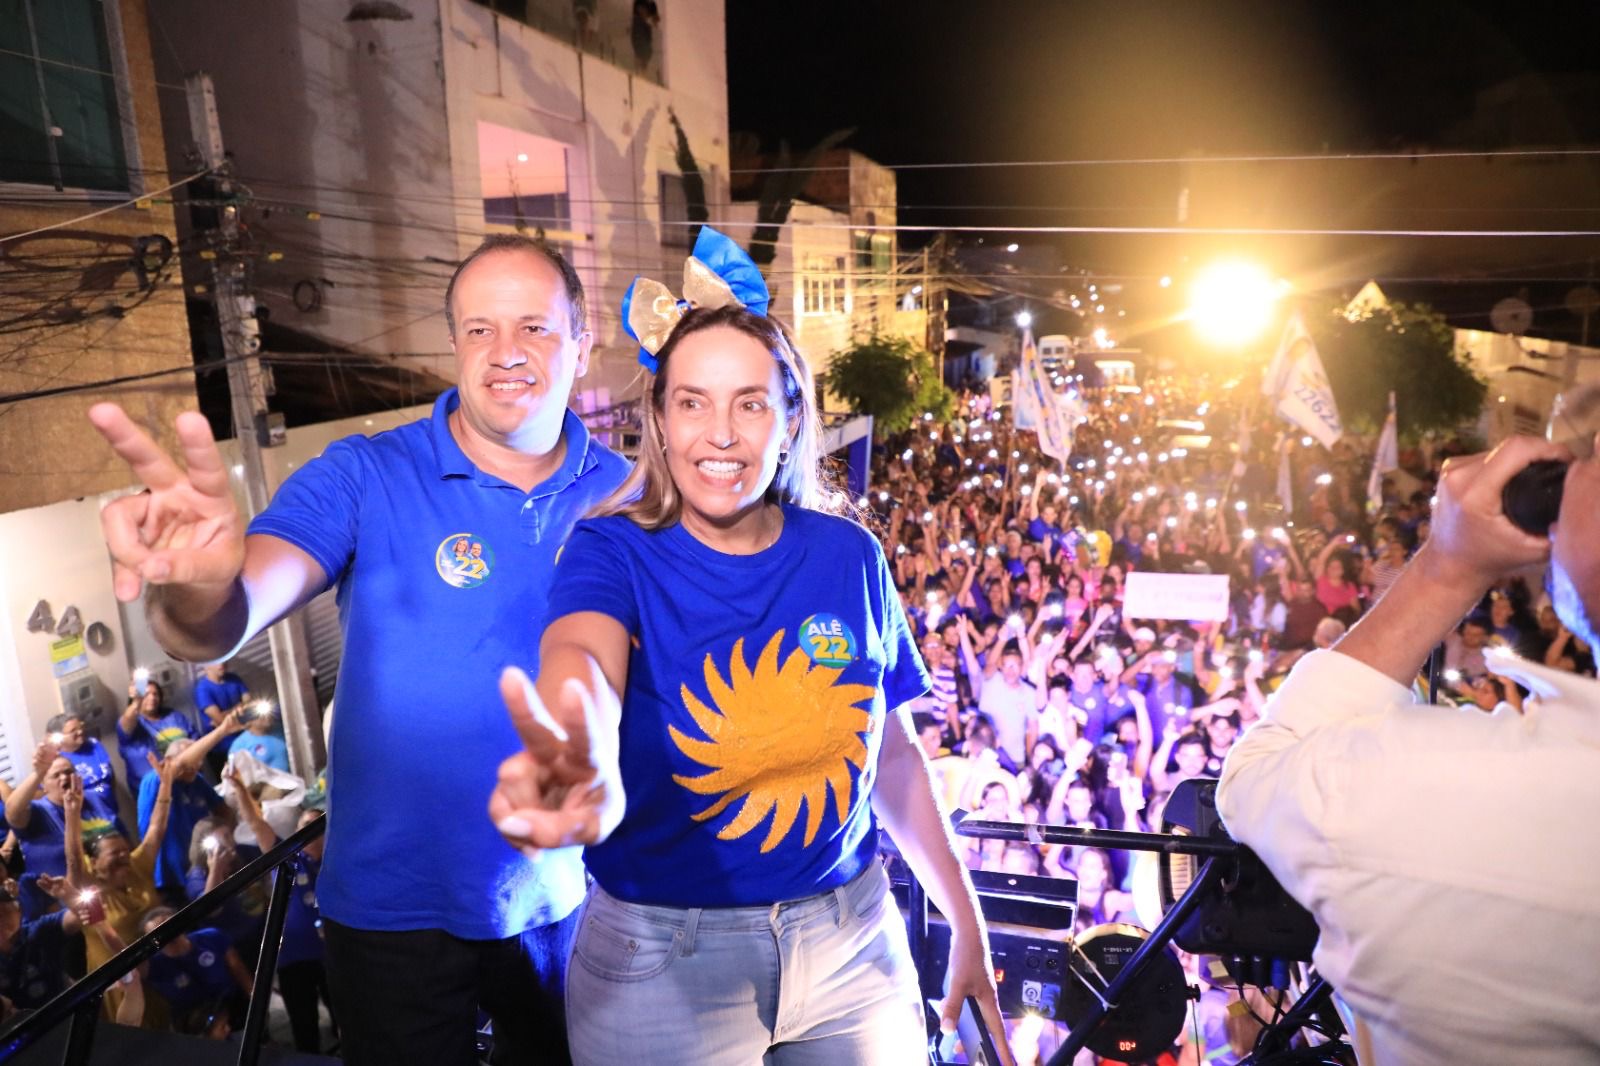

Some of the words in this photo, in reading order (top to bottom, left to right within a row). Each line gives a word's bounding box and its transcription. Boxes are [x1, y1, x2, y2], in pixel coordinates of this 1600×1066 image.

[453, 556, 482, 579] 22
[27, 598, 115, 657] 440
[810, 635, 852, 660] 22
